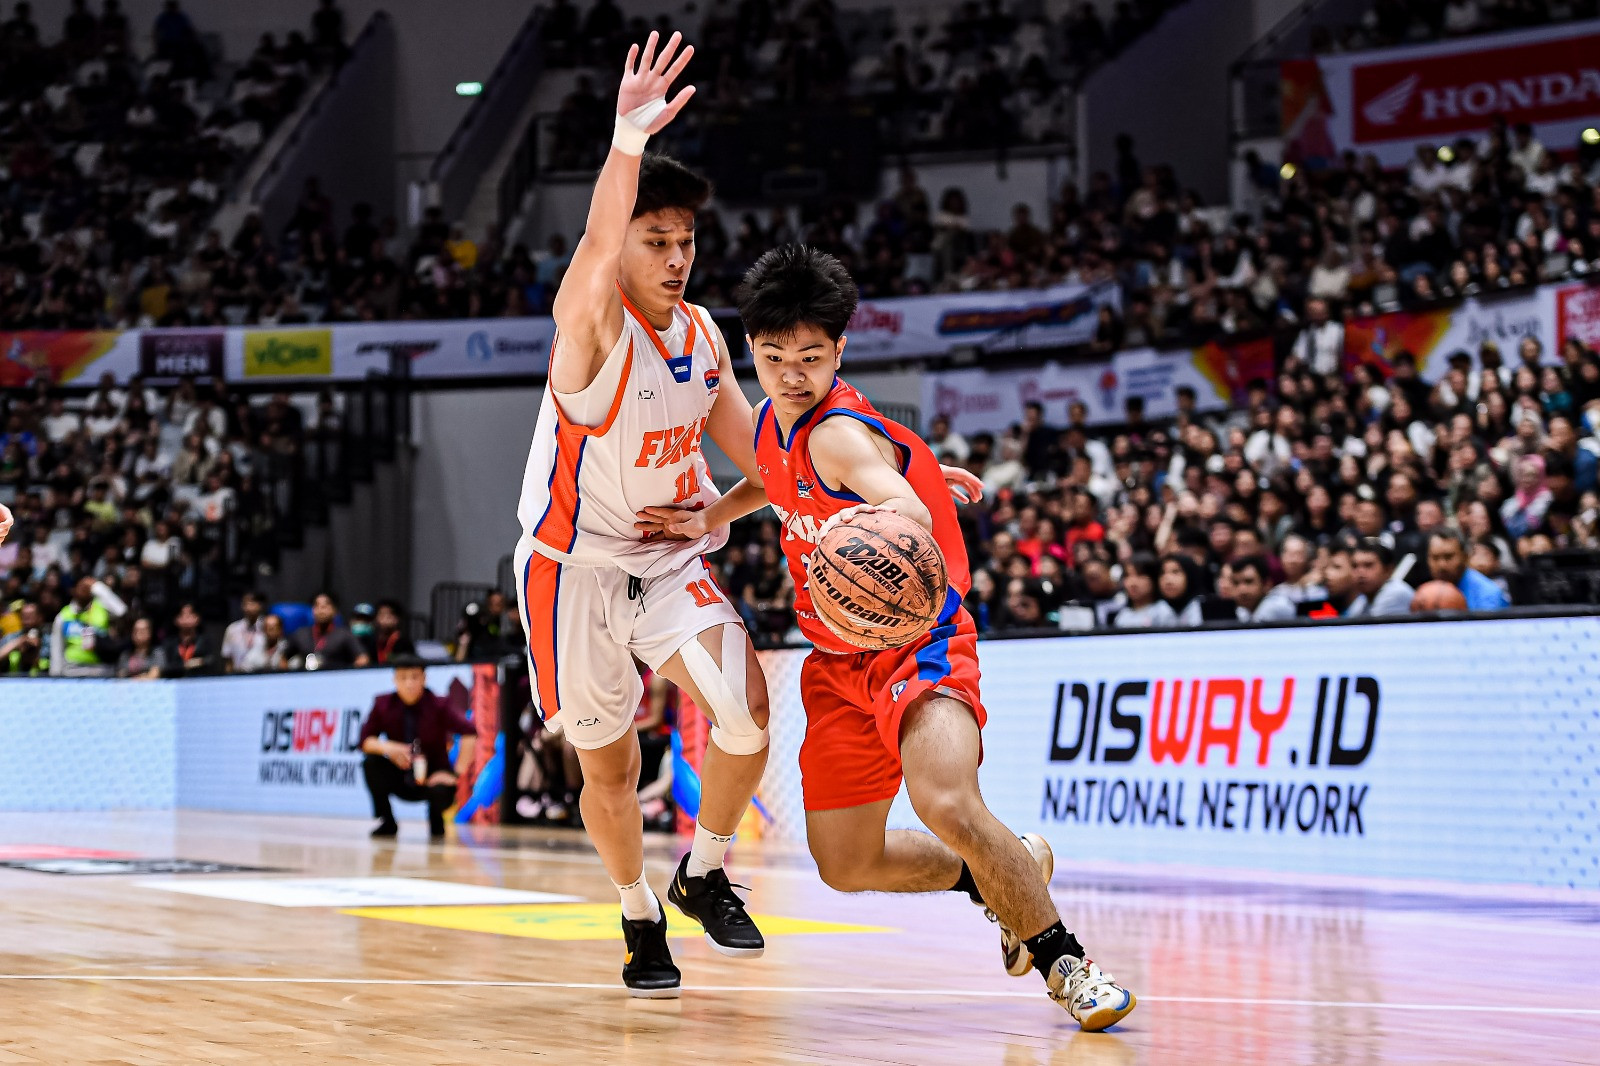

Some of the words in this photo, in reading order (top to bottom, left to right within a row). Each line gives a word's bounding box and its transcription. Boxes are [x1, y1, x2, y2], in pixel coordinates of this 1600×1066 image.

[1422, 68, 1600, 120] HONDA
[685, 578, 724, 608] 11
[860, 564, 898, 596] INDONESIA
[261, 709, 361, 753] DISWAY.ID
[1048, 674, 1380, 767] DISWAY.ID
[259, 759, 304, 784] NATIONAL
[1041, 776, 1186, 829] NATIONAL
[1197, 779, 1370, 837] NETWORK
